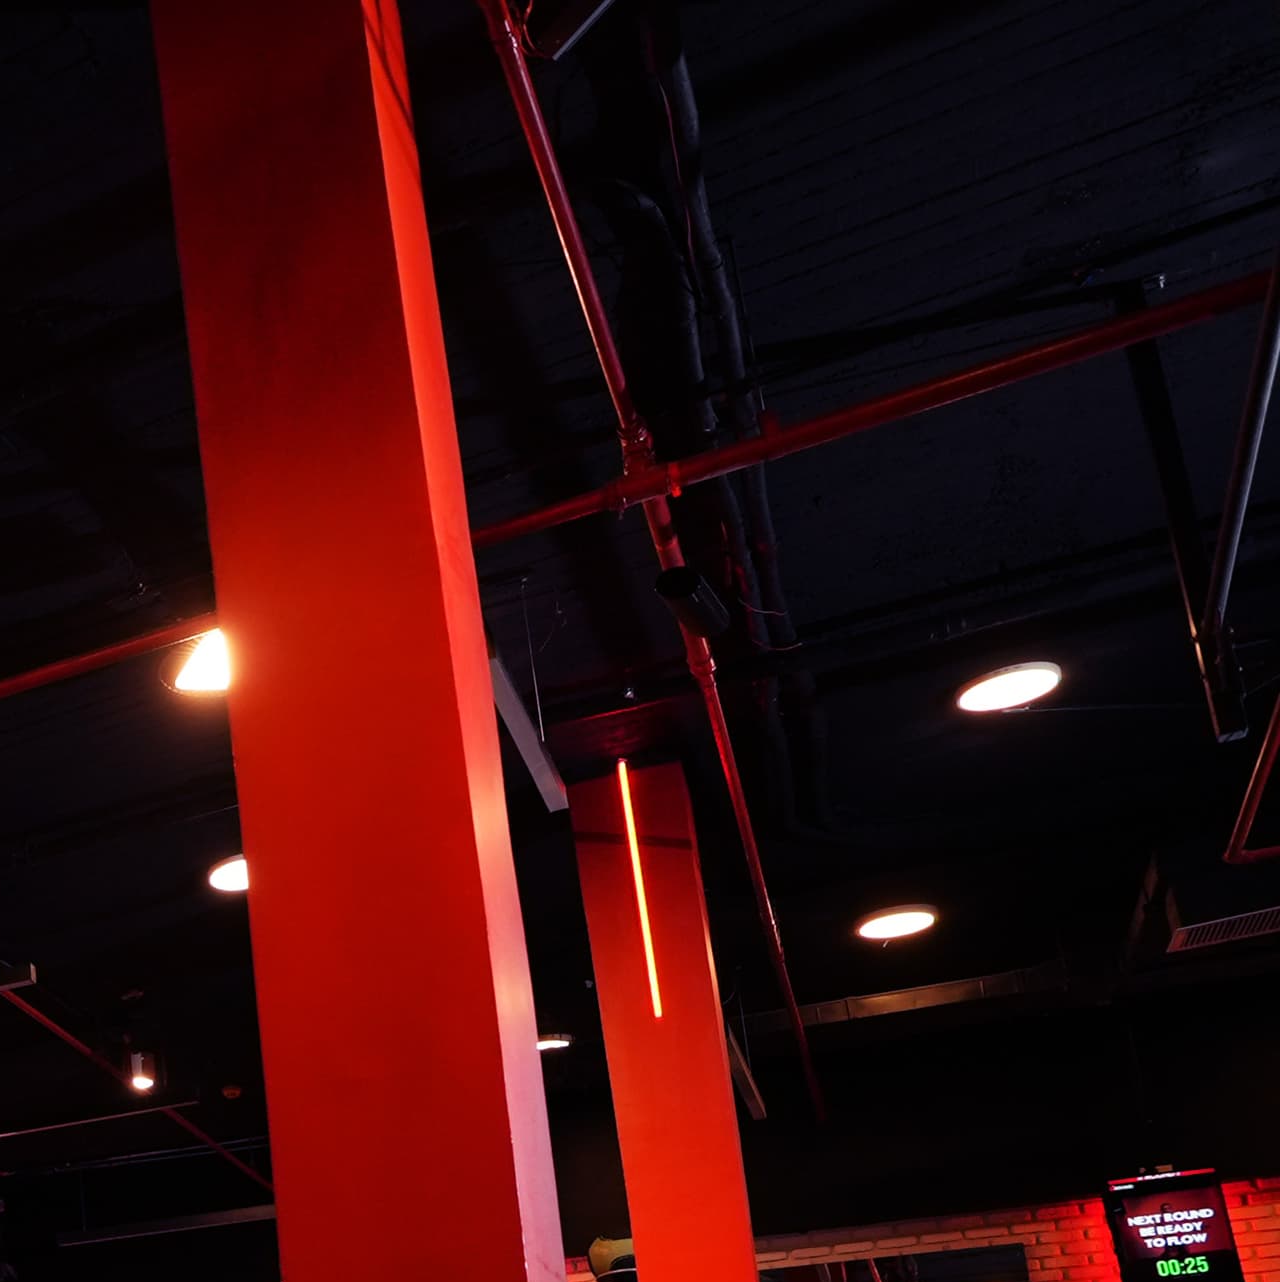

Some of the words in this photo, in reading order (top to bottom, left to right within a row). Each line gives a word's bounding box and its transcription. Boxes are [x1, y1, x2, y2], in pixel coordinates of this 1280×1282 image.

[1127, 1213, 1161, 1227] NEXT
[1164, 1208, 1215, 1223] ROUND
[1157, 1221, 1203, 1235] READY
[1144, 1237, 1165, 1249] TO
[1167, 1233, 1208, 1246] FLOW
[1155, 1255, 1210, 1277] 00:25
